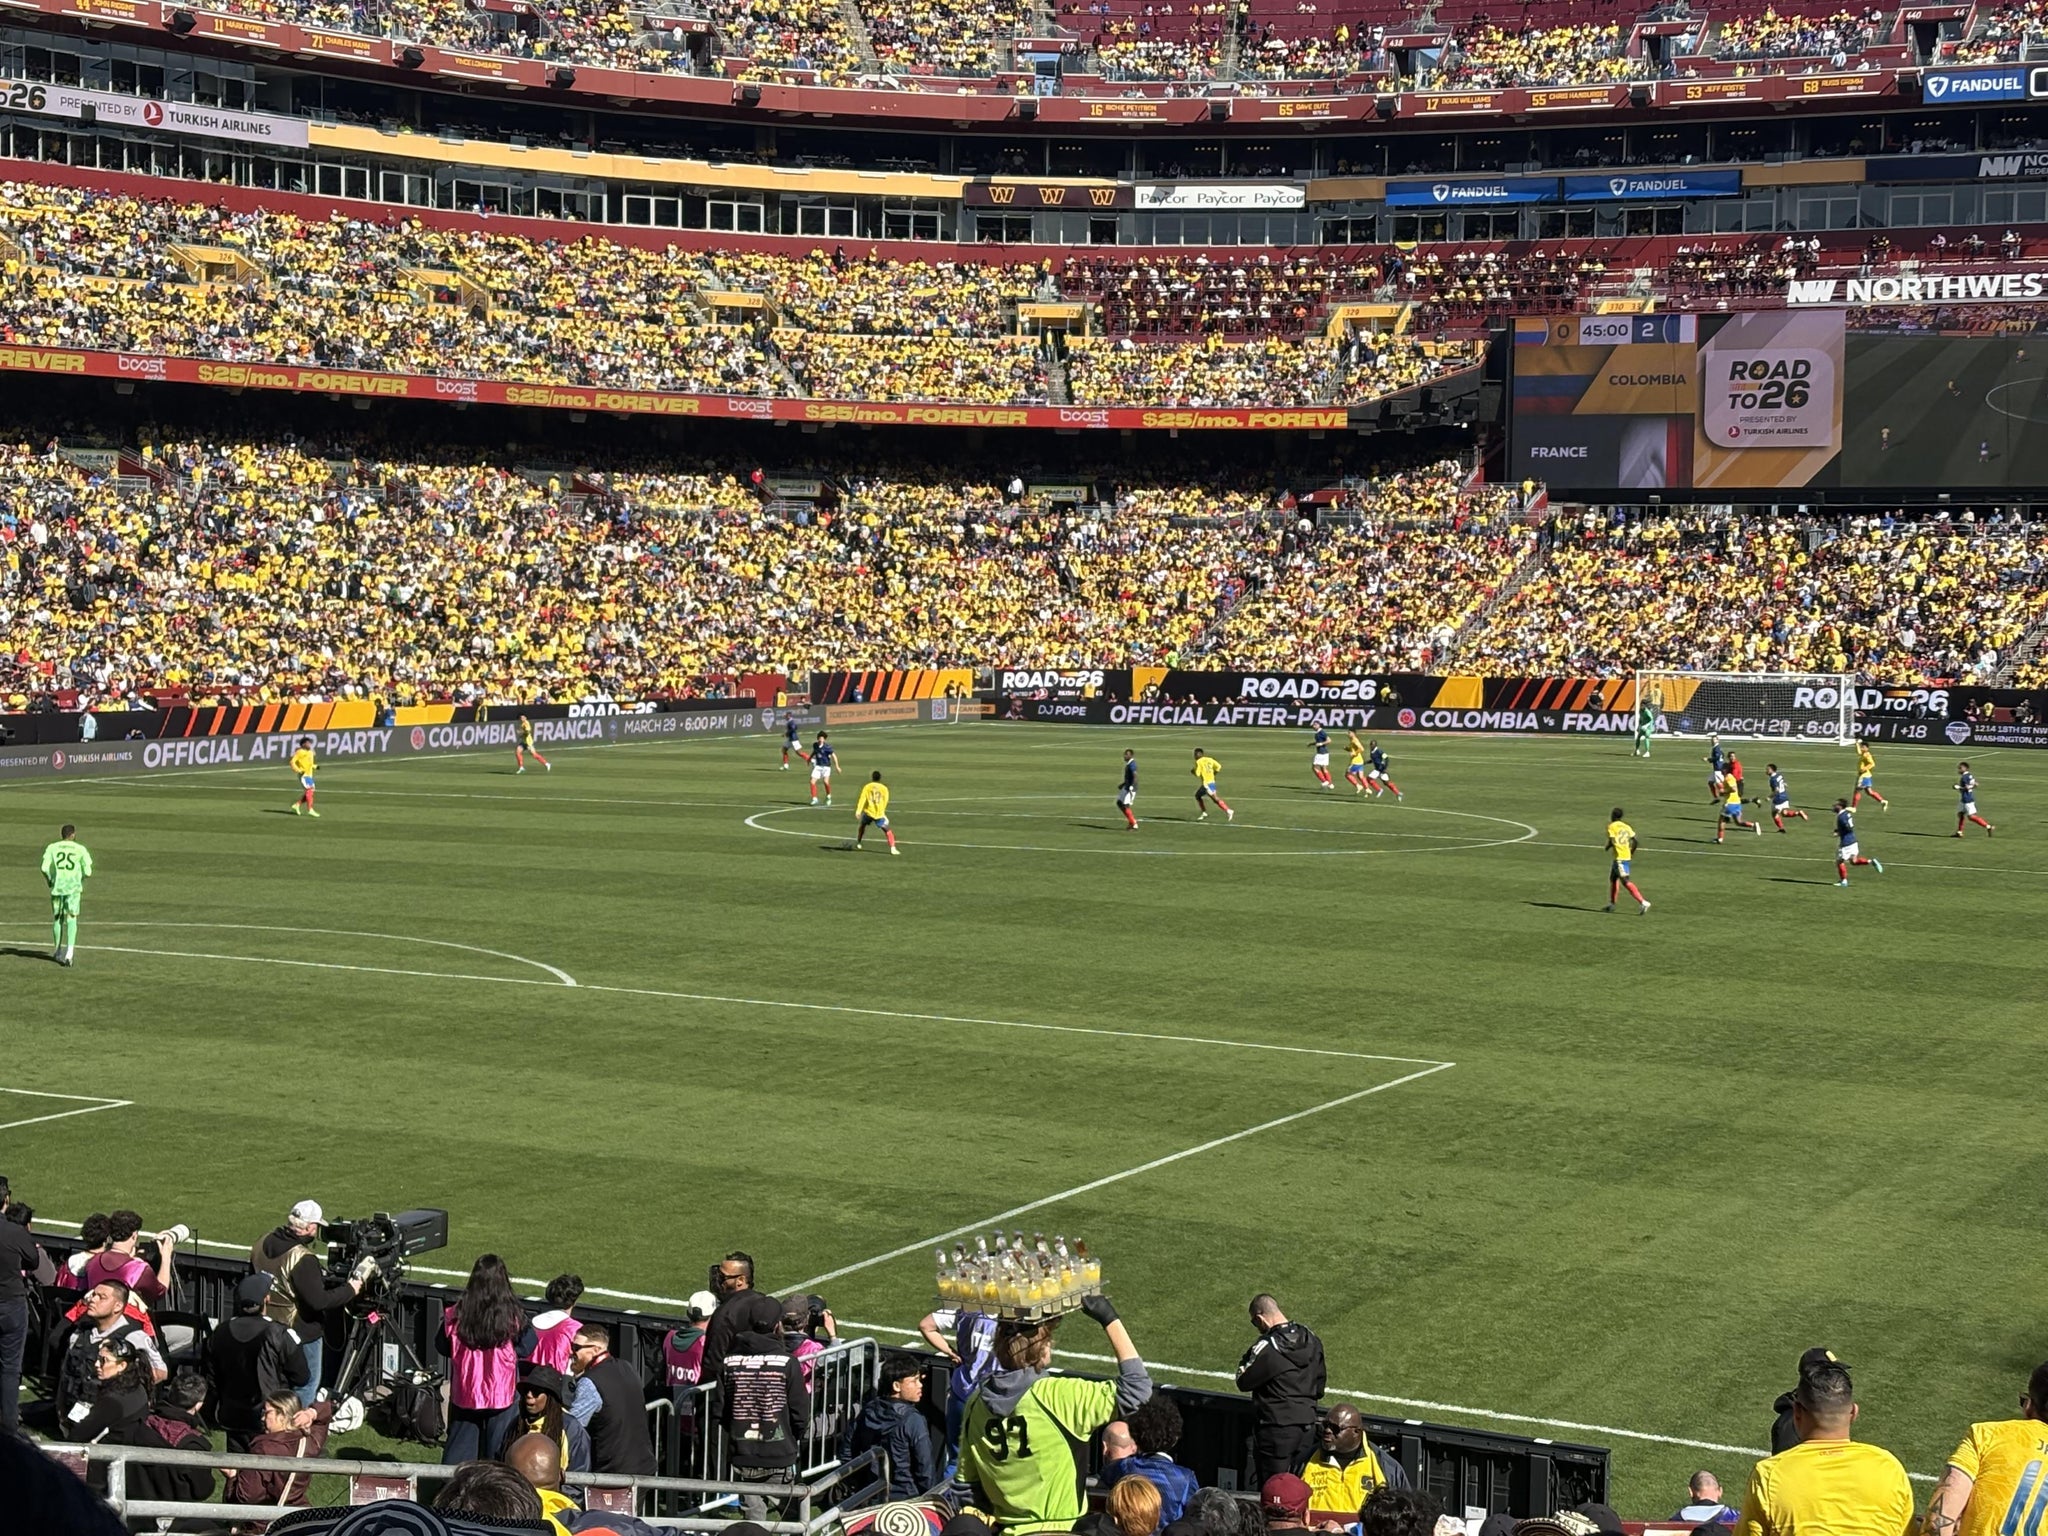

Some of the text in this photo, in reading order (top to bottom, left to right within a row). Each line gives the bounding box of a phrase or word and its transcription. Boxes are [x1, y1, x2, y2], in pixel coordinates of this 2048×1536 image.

[214, 19, 224, 32] 11
[312, 35, 323, 48] 71
[1687, 87, 1702, 99] 53
[1803, 81, 1819, 93] 68
[1951, 77, 2023, 93] FANDUEL
[1426, 98, 1438, 110] 17
[1532, 94, 1547, 106] 55
[124, 106, 137, 117] BY
[1090, 104, 1103, 116] 16
[1279, 104, 1293, 116] 65
[169, 111, 271, 136] TURKISH AIRLINES
[1978, 155, 2024, 177] NW
[1452, 186, 1508, 198] FANDUEL
[1629, 179, 1687, 193] FANDUEL
[1140, 191, 1189, 204] Paycor
[1197, 191, 1246, 204] Paycor
[1787, 279, 1838, 303] NW
[1557, 324, 1570, 339] 0
[1582, 324, 1629, 338] 45:00
[1641, 322, 1655, 337] 2
[118, 355, 167, 373] boost
[1729, 359, 1812, 381] ROAD
[198, 365, 409, 395] $25/mo. FOREVER
[435, 379, 478, 395] boost
[1609, 374, 1687, 386] COLOMBIA
[506, 386, 700, 413] $25/mo. FOREVER
[728, 398, 774, 414] boost
[1728, 393, 1758, 409] TO
[805, 405, 1028, 425] $25/mo. FOREVER
[1060, 409, 1109, 423] boost
[1142, 411, 1244, 428] $25/mo.
[1786, 415, 1798, 423] BY
[1530, 446, 1588, 458] FRANCE
[1002, 670, 1105, 688] ROAD TO 26
[1241, 678, 1377, 700] ROAD TO 26
[1793, 688, 1883, 710] ROAD
[1884, 698, 1908, 711] TO
[1038, 705, 1088, 716] DJ POPE
[1110, 704, 1375, 727] OFFICIAL AFTER-PARTY
[624, 718, 662, 735] MARCH
[662, 717, 677, 732] 29
[684, 716, 709, 731] 6:00
[1420, 710, 1540, 730] COLOMBIA
[1705, 717, 1766, 732] MARCH
[1768, 719, 1791, 733] 29
[1899, 725, 1928, 739] +18
[428, 719, 603, 748] COLOMBIA FRANCIA
[1974, 735, 2034, 745] WASHINGTON,
[39, 755, 49, 765] BY
[68, 751, 133, 764] TURKISH AIRLINES
[143, 739, 244, 768] OFFICIAL
[56, 851, 76, 871] 25
[985, 1415, 1034, 1461] 97
